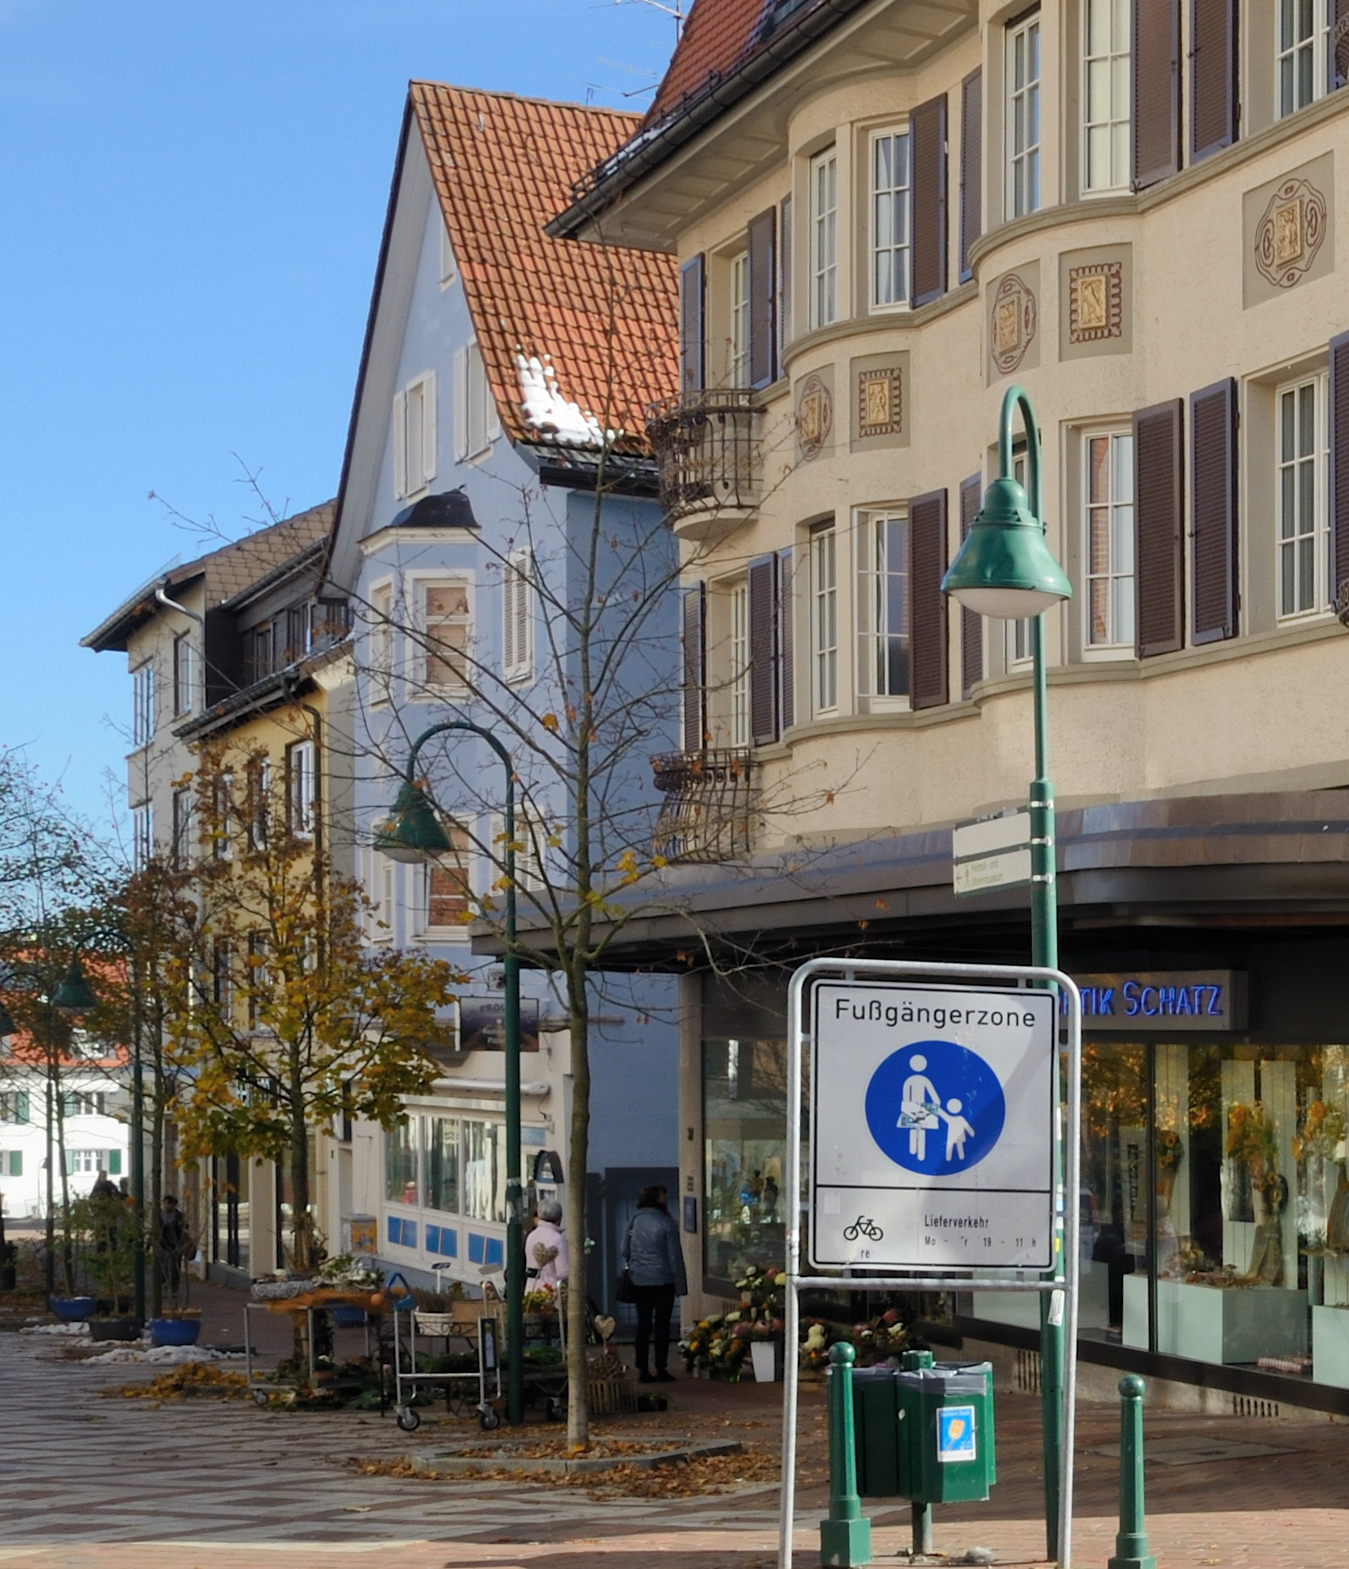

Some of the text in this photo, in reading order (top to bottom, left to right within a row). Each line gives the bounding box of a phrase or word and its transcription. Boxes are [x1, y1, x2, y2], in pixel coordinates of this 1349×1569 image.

[1123, 981, 1222, 1017] SCHATZ
[835, 998, 1036, 1029] Fußgängerzone
[924, 1214, 990, 1229] Lieferverkehr
[960, 1235, 968, 1247] r
